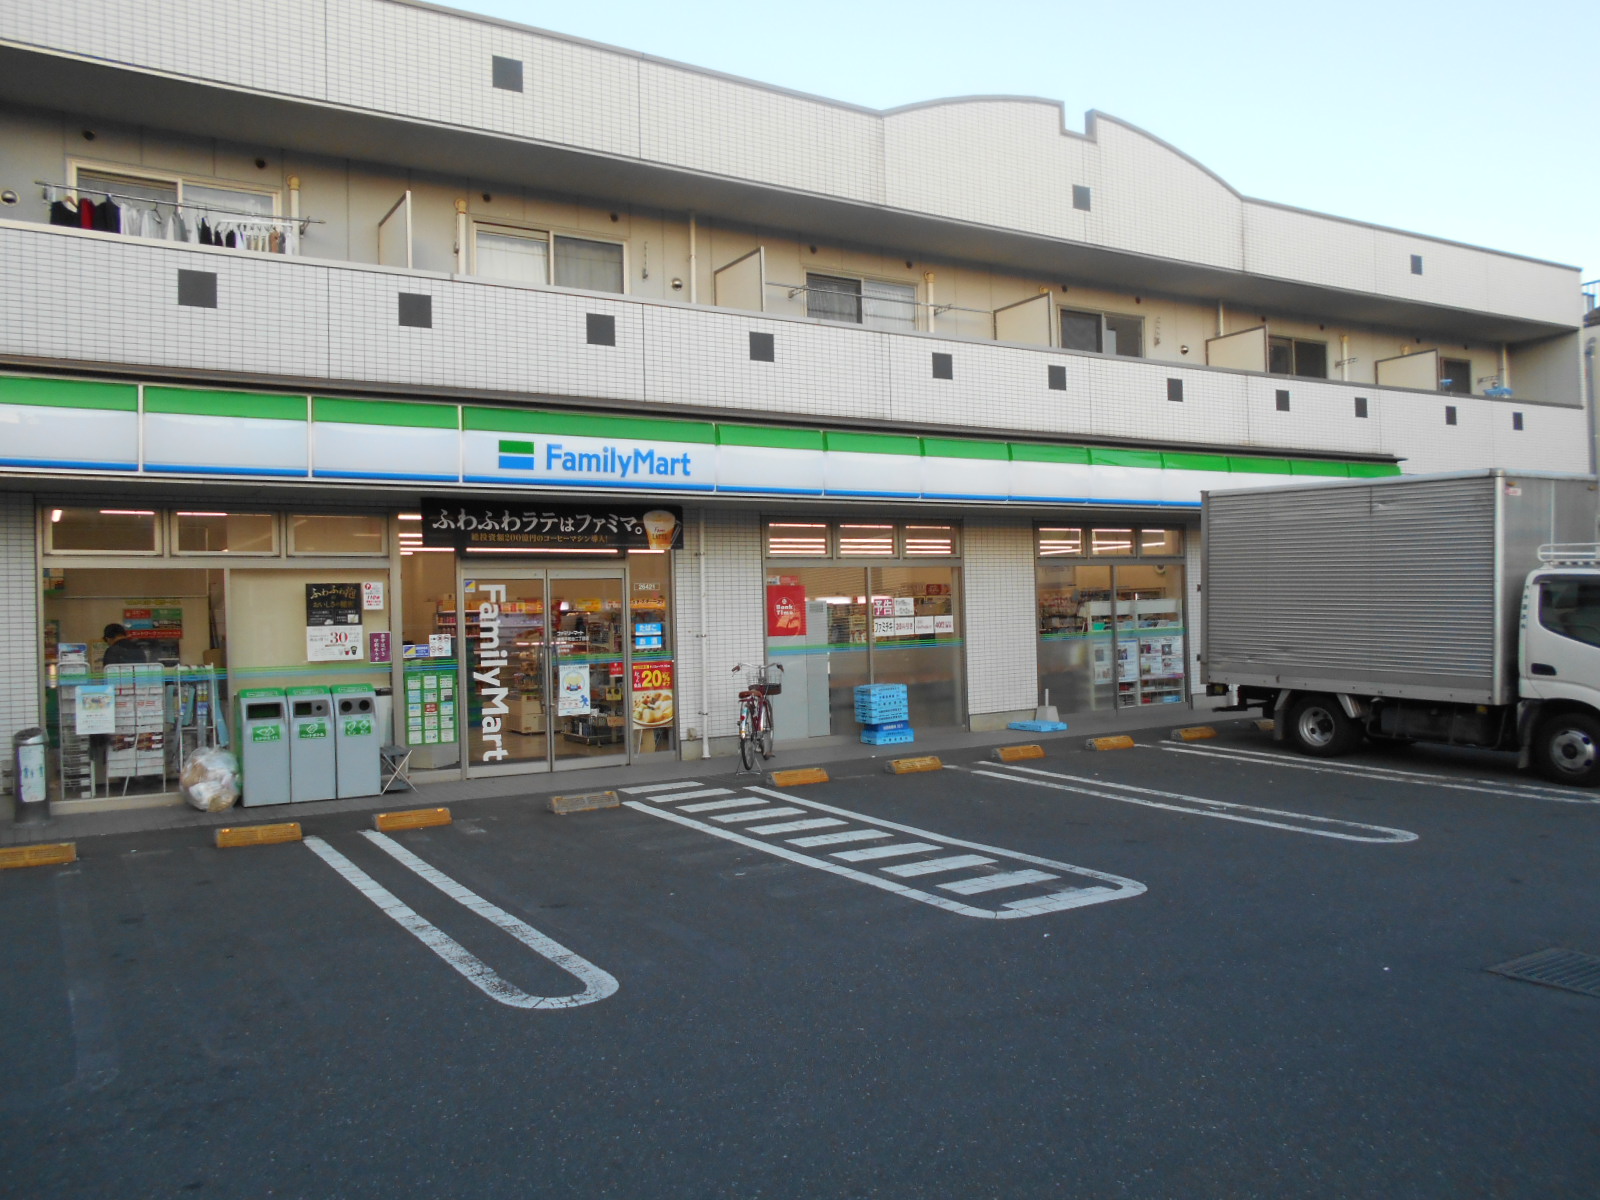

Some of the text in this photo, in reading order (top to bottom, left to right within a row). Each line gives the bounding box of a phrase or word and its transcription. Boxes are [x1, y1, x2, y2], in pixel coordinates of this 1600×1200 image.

[546, 443, 691, 478] FamilyMart
[432, 508, 643, 533] ふわふわラテはファミマ。
[874, 600, 893, 616] 予告
[330, 632, 348, 643] 30
[473, 584, 510, 762] FamilyMart
